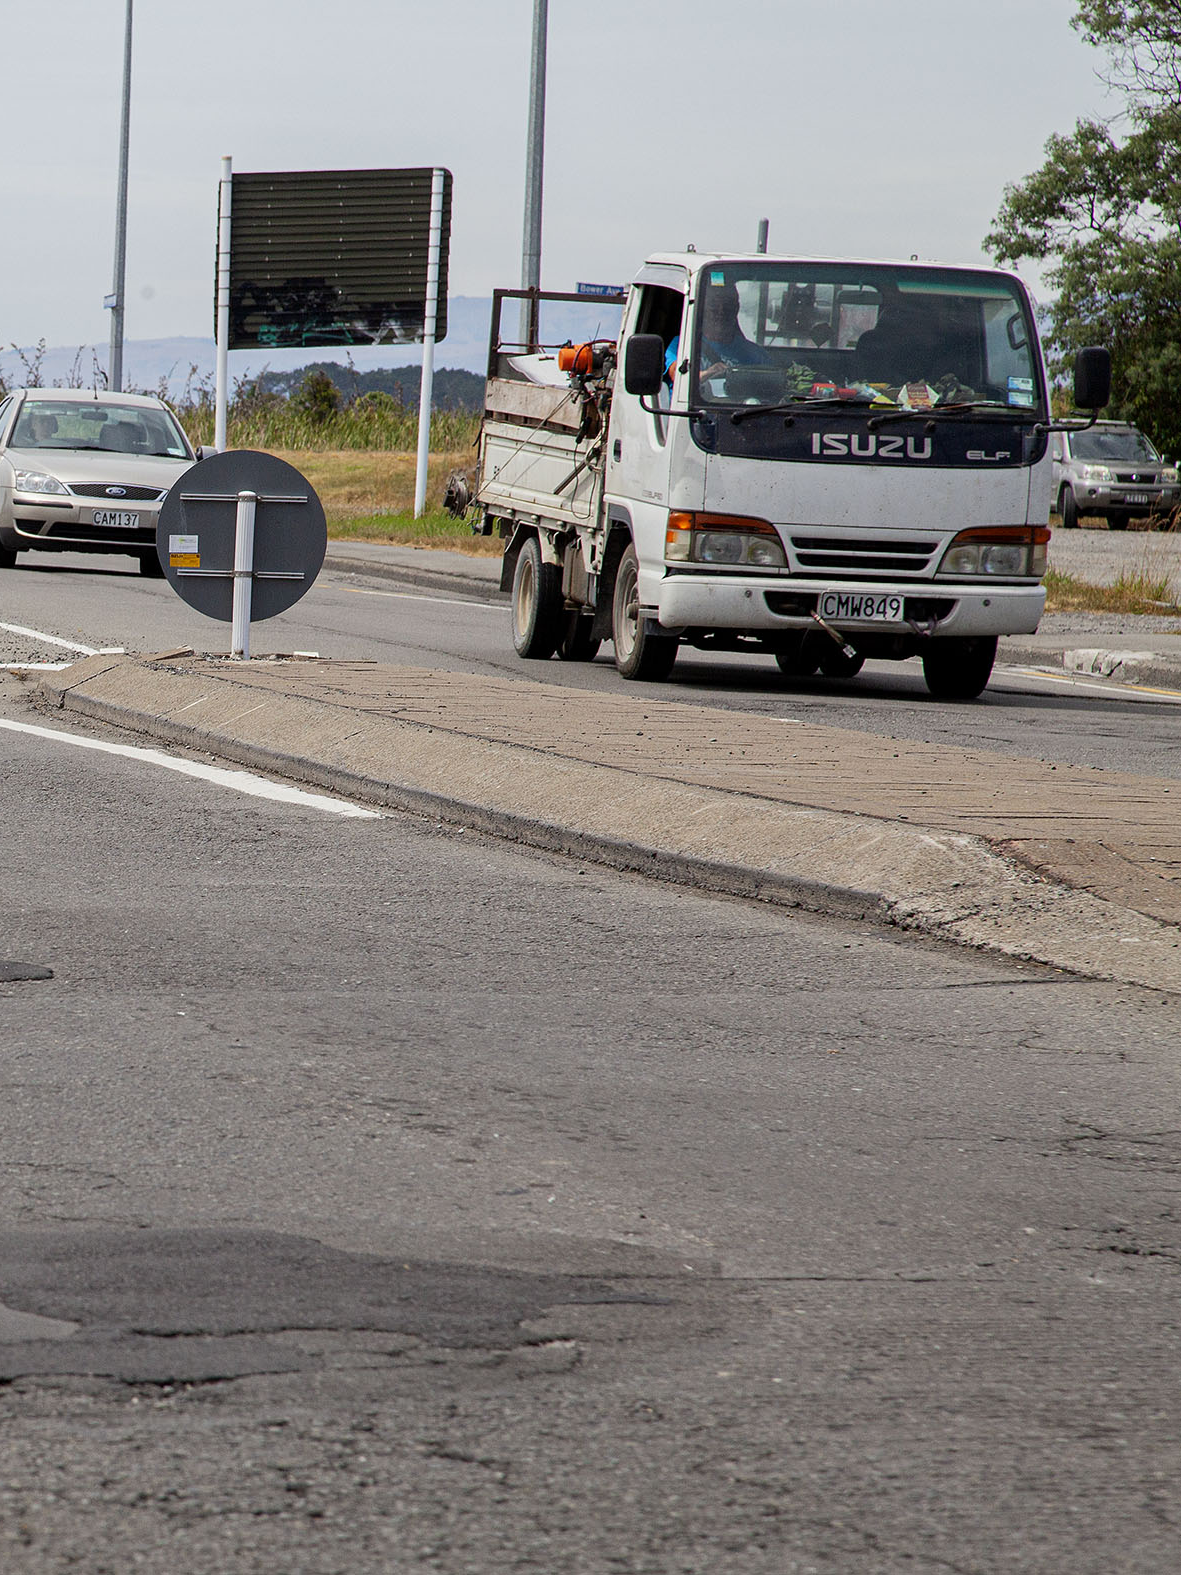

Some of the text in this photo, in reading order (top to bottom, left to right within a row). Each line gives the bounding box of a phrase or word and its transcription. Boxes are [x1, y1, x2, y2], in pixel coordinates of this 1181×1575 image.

[812, 433, 932, 459] ISUZU
[967, 450, 1011, 460] ELF
[94, 512, 138, 526] CAM137
[825, 596, 900, 619] CMW849
